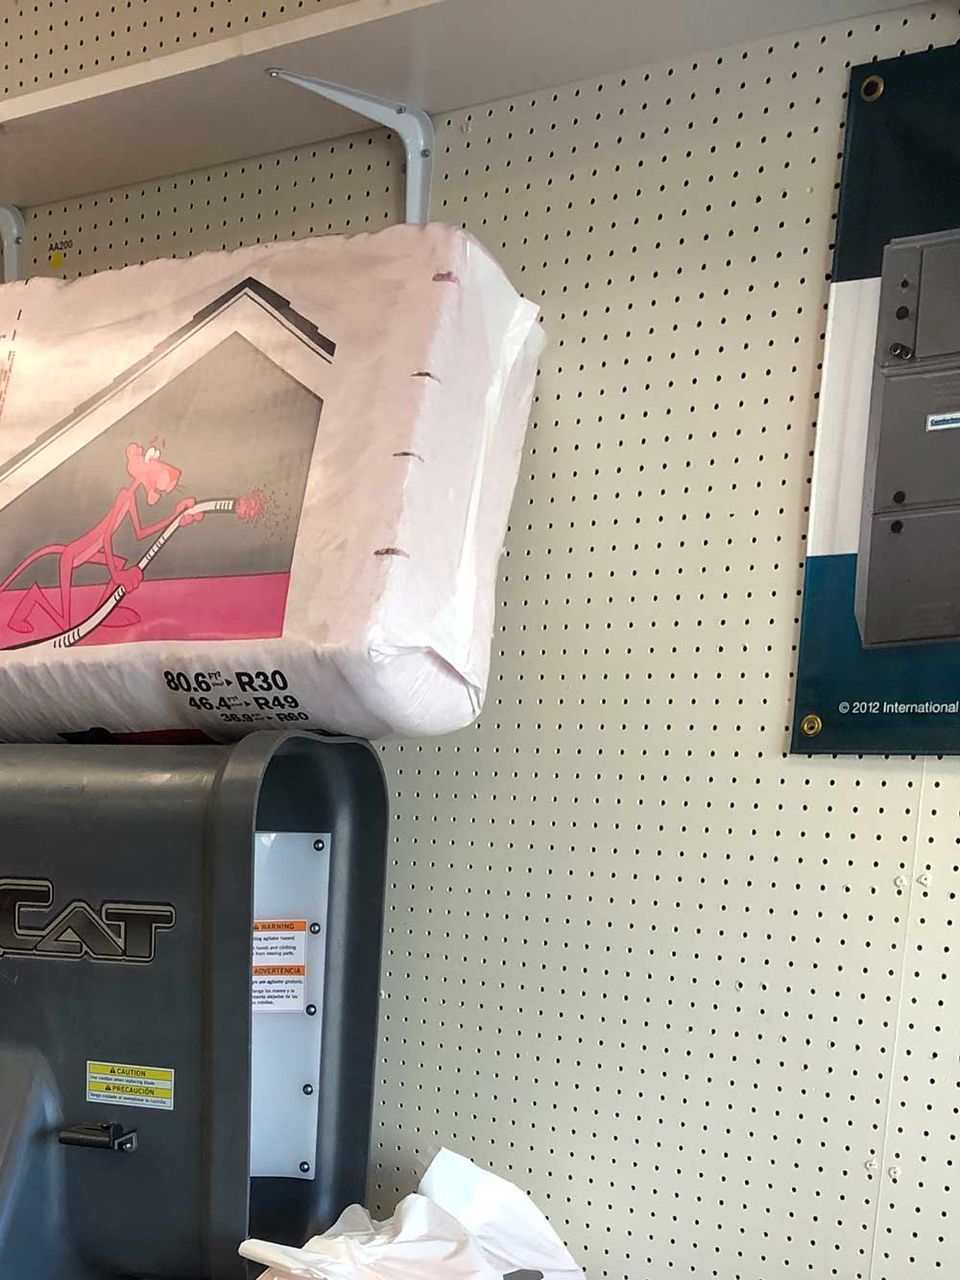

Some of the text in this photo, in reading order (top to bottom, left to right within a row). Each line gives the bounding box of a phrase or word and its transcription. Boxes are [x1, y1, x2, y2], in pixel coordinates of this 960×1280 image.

[48, 240, 73, 251] AA200
[164, 670, 288, 692] 80.6 R30
[189, 695, 300, 710] 46.4 R49
[852, 700, 959, 714] 2012 International
[117, 1068, 146, 1077] CAUTION
[112, 1085, 154, 1095] PRECAUCIÓN
